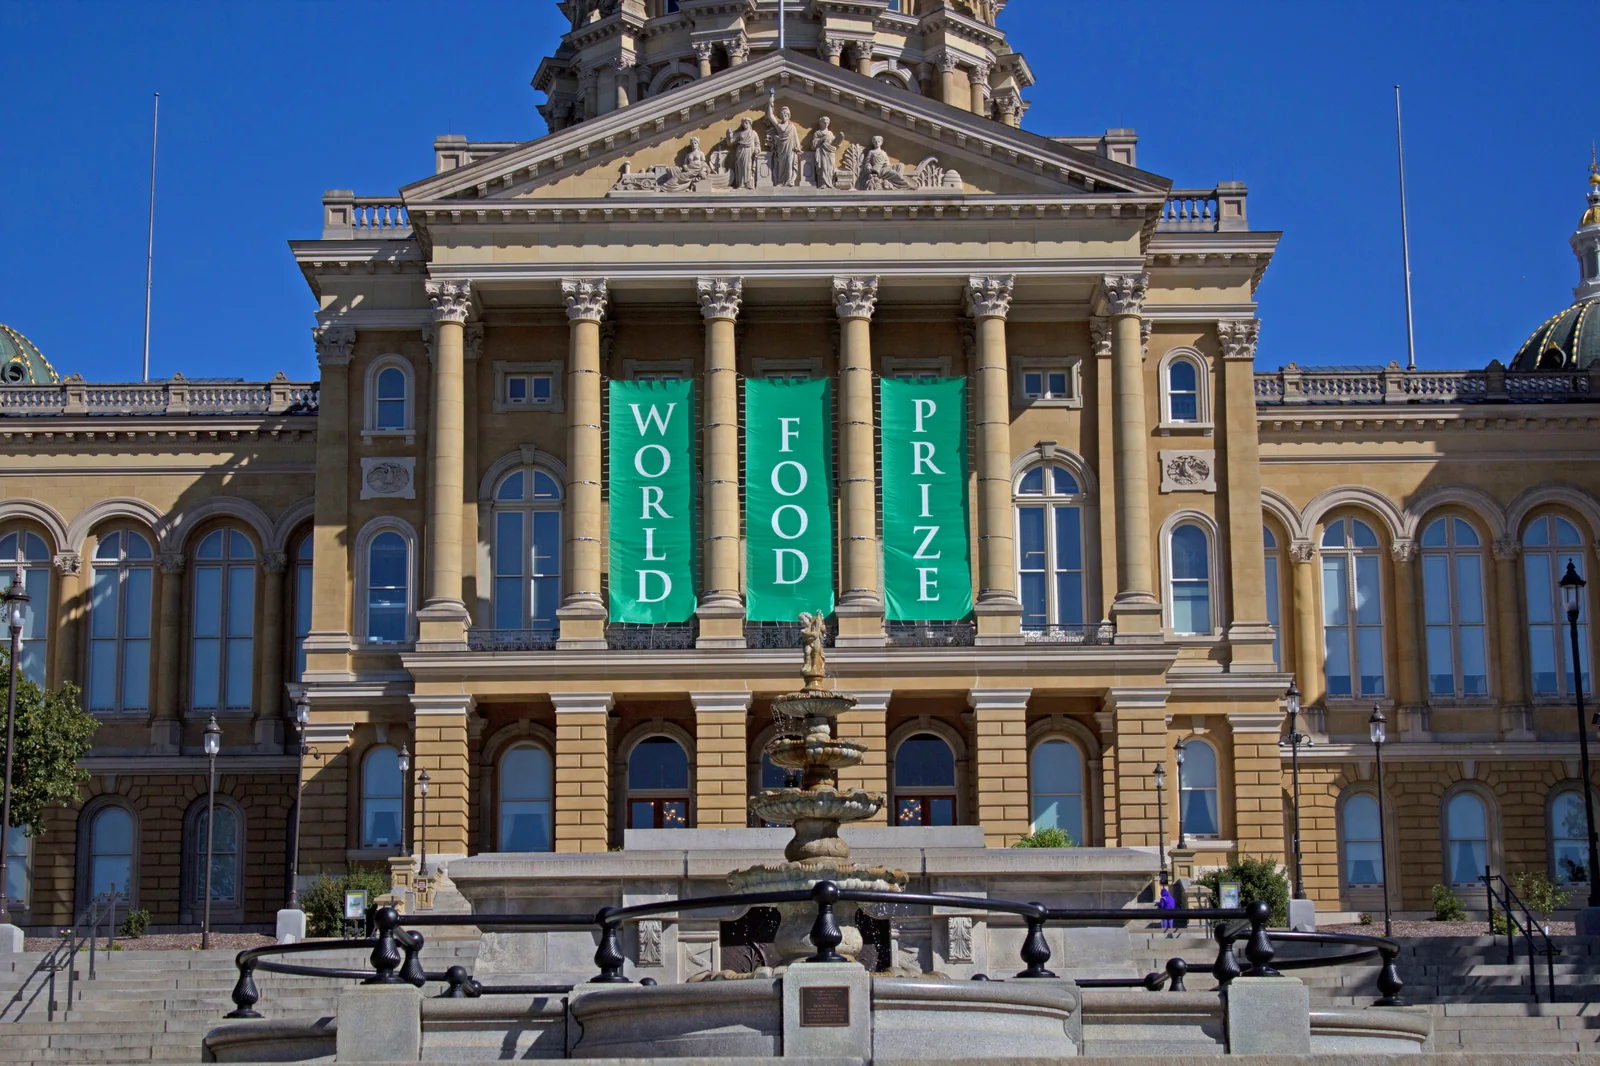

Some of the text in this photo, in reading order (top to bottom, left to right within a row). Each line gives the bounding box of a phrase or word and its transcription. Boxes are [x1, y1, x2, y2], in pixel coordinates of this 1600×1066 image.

[628, 402, 677, 603] WORLD
[771, 417, 809, 585] FOOD
[911, 399, 946, 602] PRIZE
